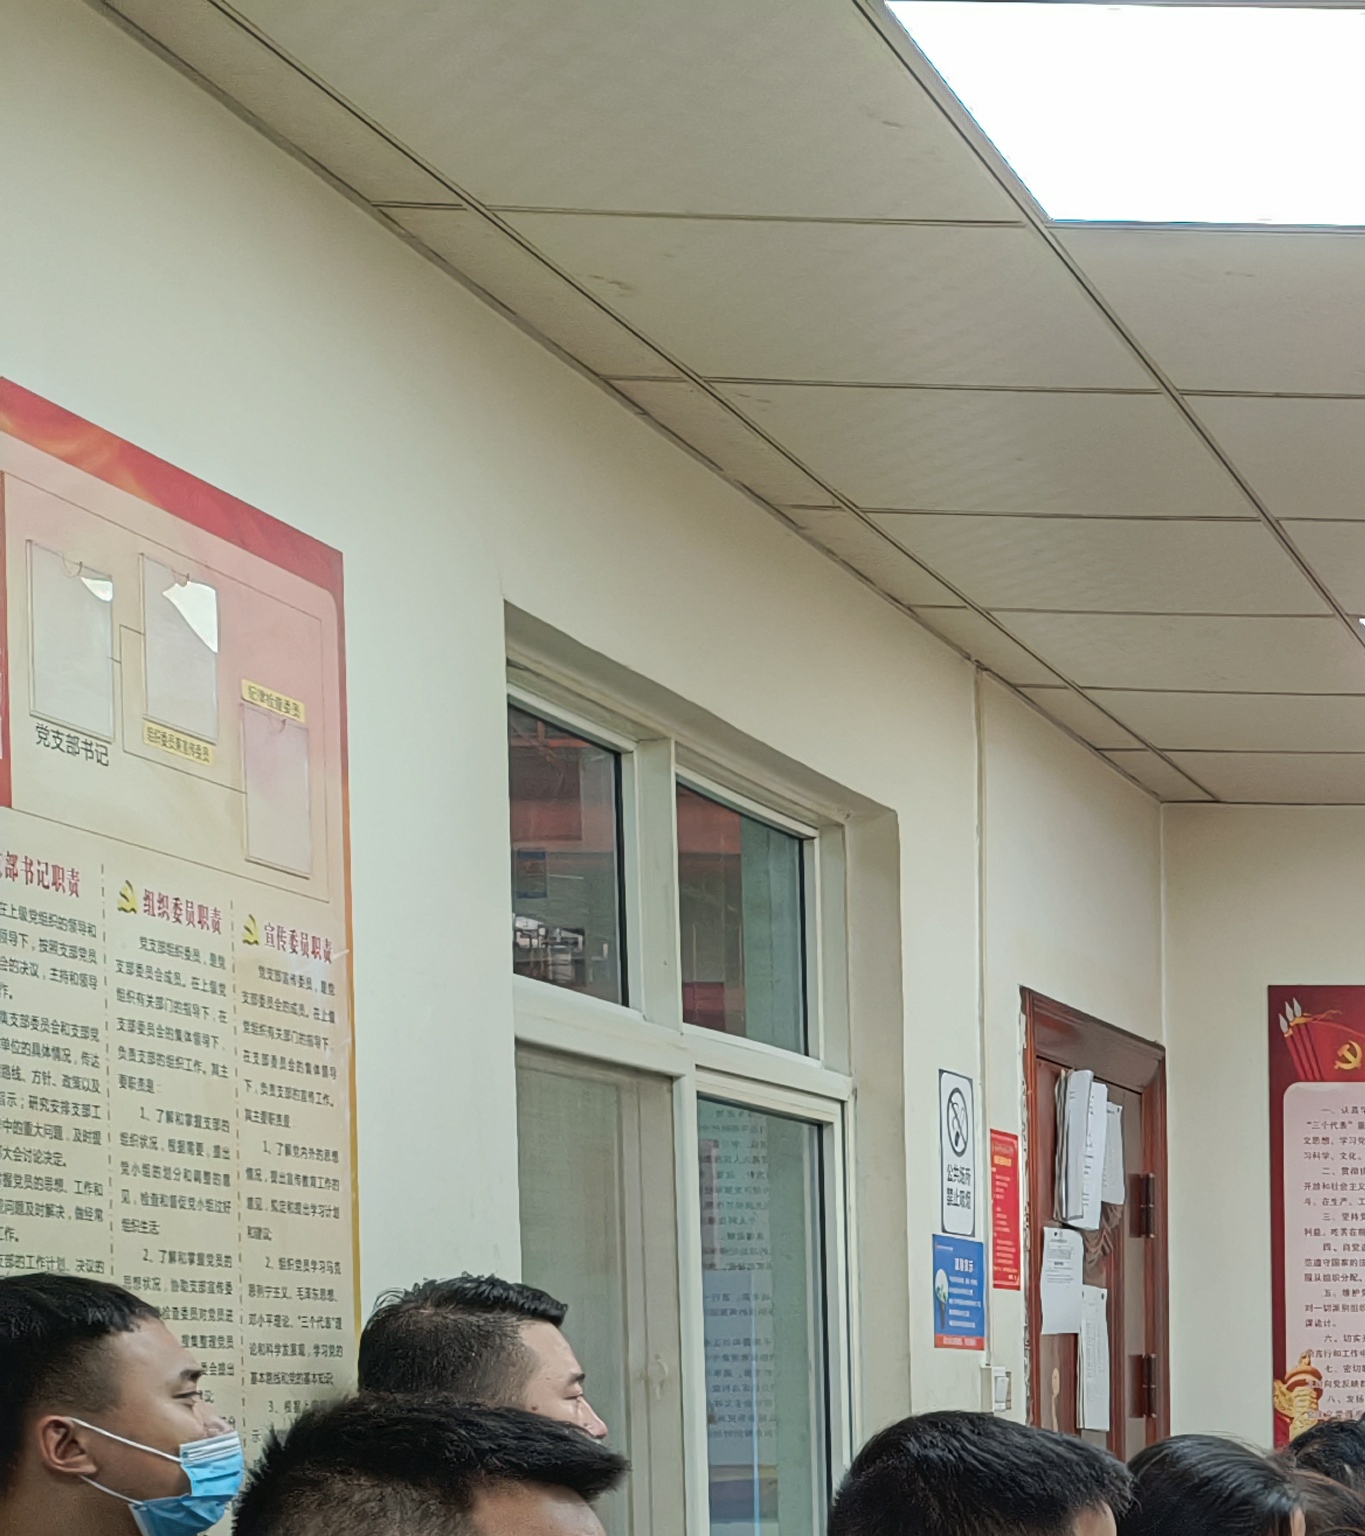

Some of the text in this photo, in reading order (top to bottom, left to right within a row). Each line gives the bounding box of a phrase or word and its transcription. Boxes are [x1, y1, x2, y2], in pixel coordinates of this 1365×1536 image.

[36, 722, 109, 767] 党支部书记
[0, 850, 80, 898] 部书记职责
[143, 888, 222, 935] 组织委员职责
[264, 922, 332, 965] 宣传委员职责
[0, 1144, 67, 1168] 大会讨论决定。
